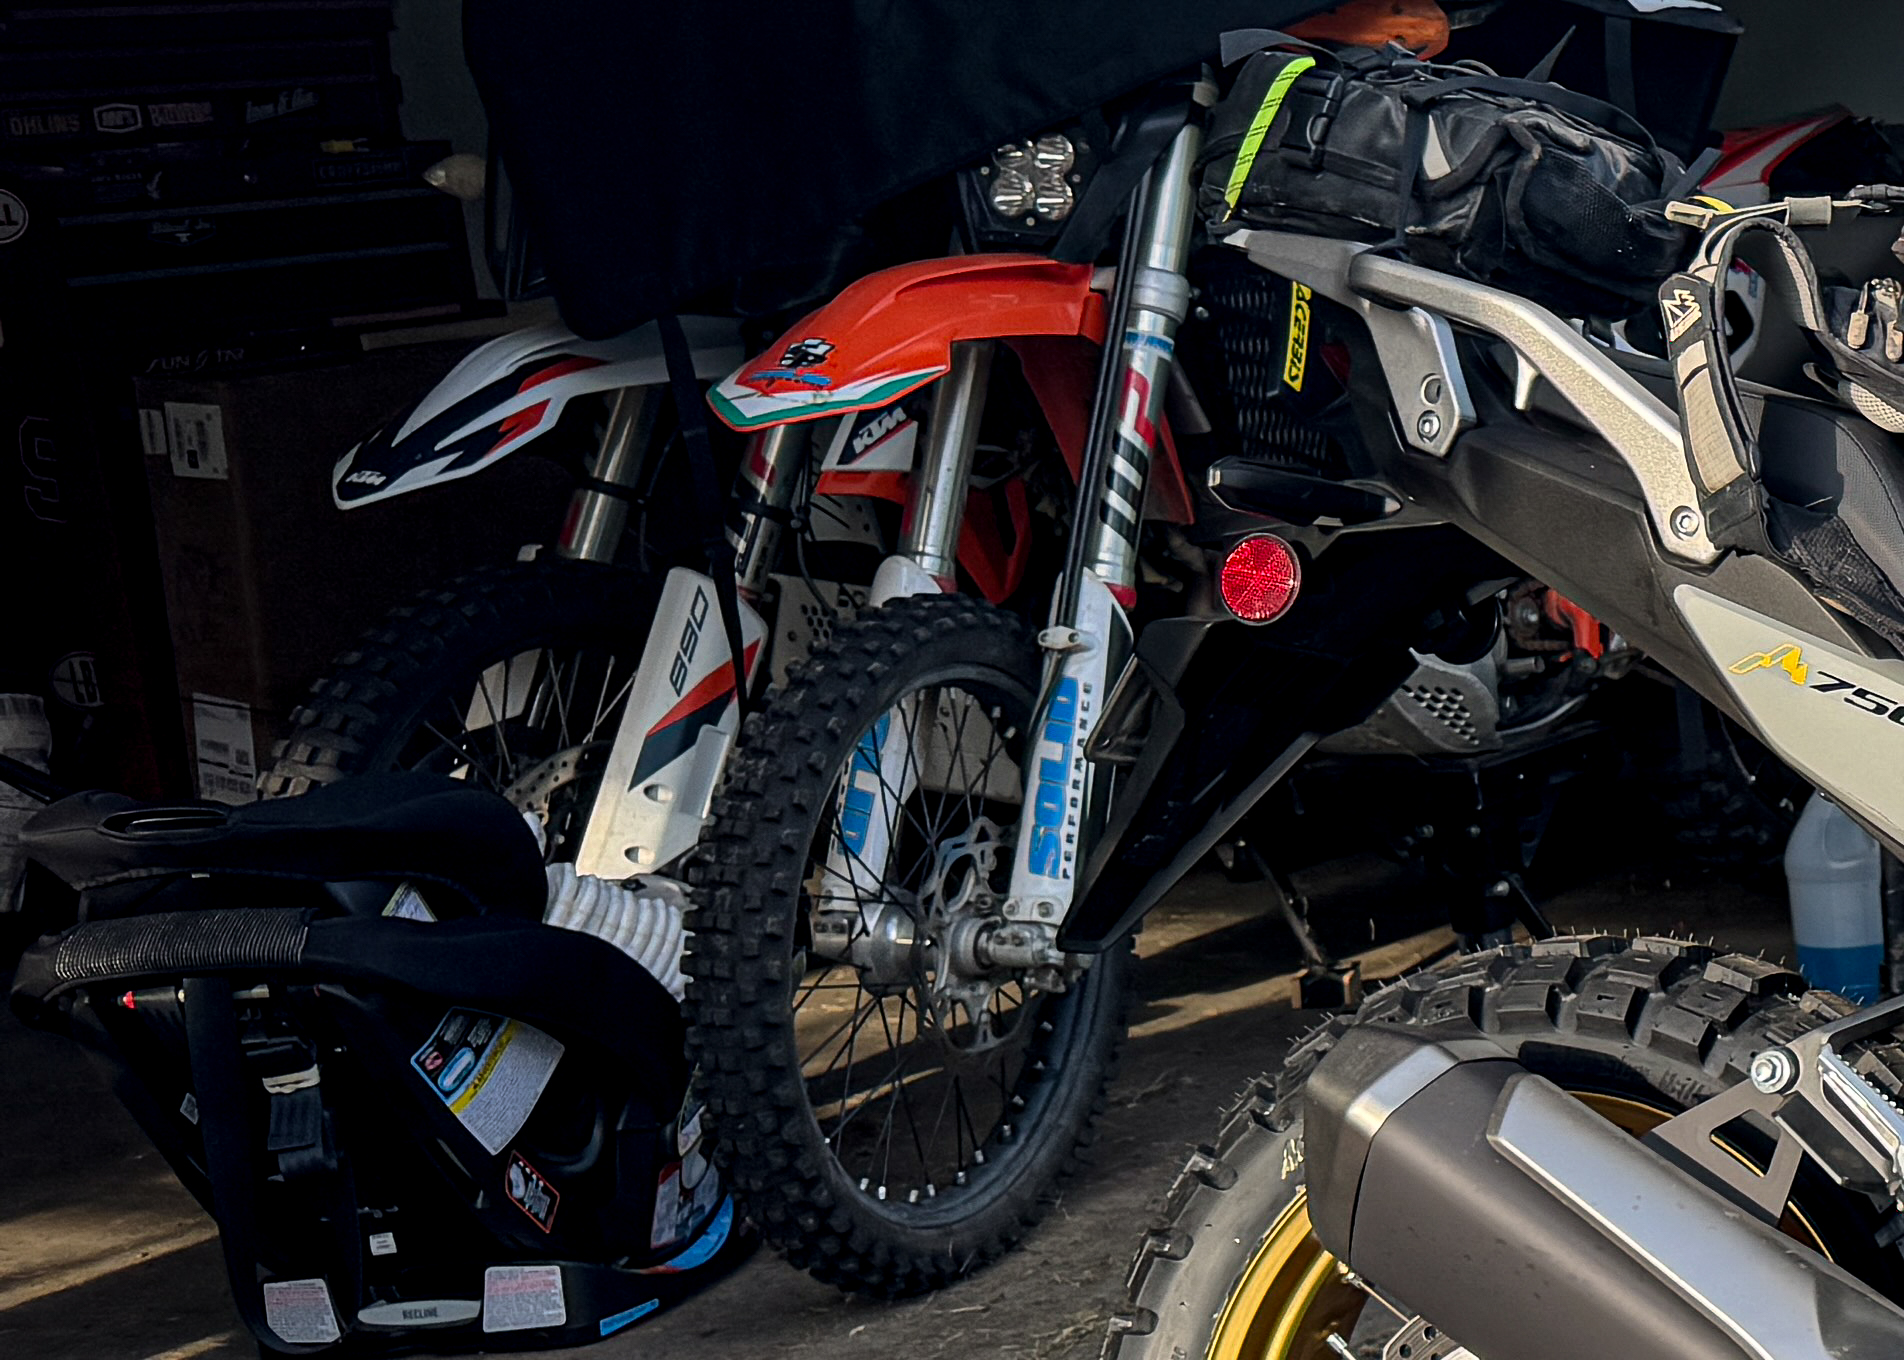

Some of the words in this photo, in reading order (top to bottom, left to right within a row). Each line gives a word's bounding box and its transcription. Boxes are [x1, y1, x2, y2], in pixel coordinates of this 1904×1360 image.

[853, 405, 909, 455] KTM
[346, 470, 386, 487] KTM
[1028, 676, 1079, 881] SOLID
